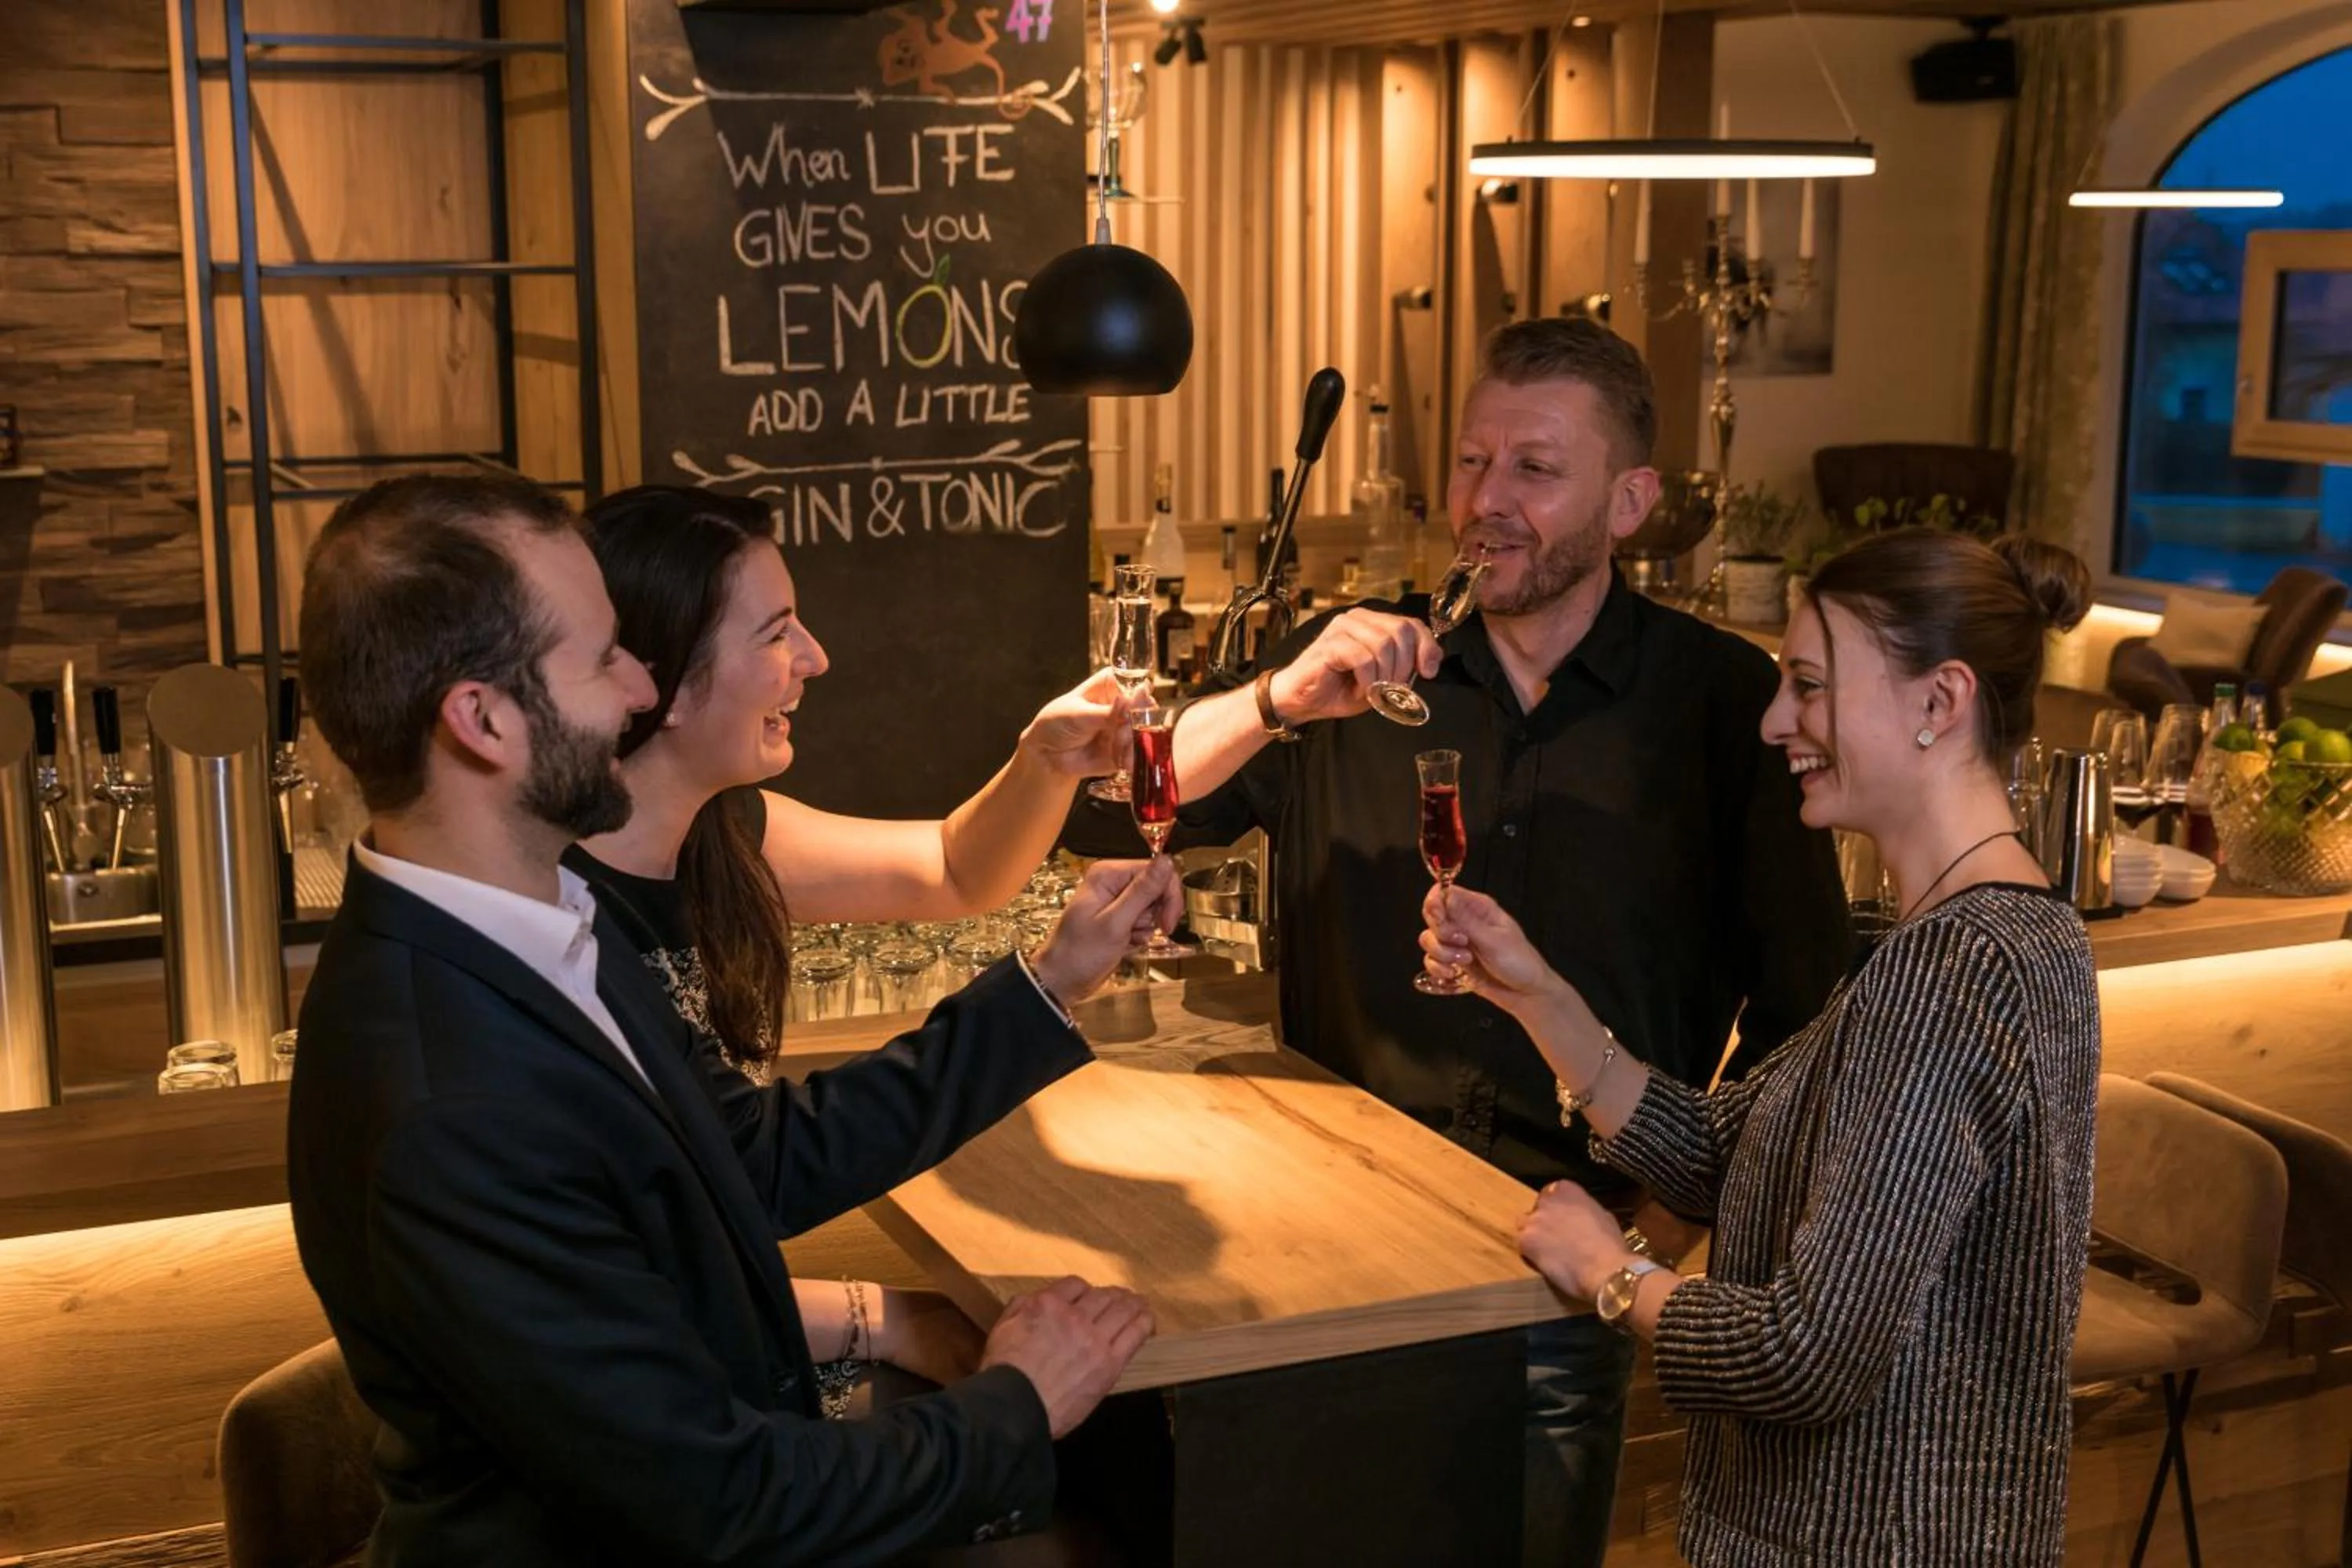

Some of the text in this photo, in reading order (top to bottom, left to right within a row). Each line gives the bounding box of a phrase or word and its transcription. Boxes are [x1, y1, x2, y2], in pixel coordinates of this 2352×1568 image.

[717, 123, 1015, 194] When LIFE
[734, 201, 992, 279] GIVES you
[748, 379, 1031, 437] ADD A LITTLE
[899, 472, 1068, 537] TONIC
